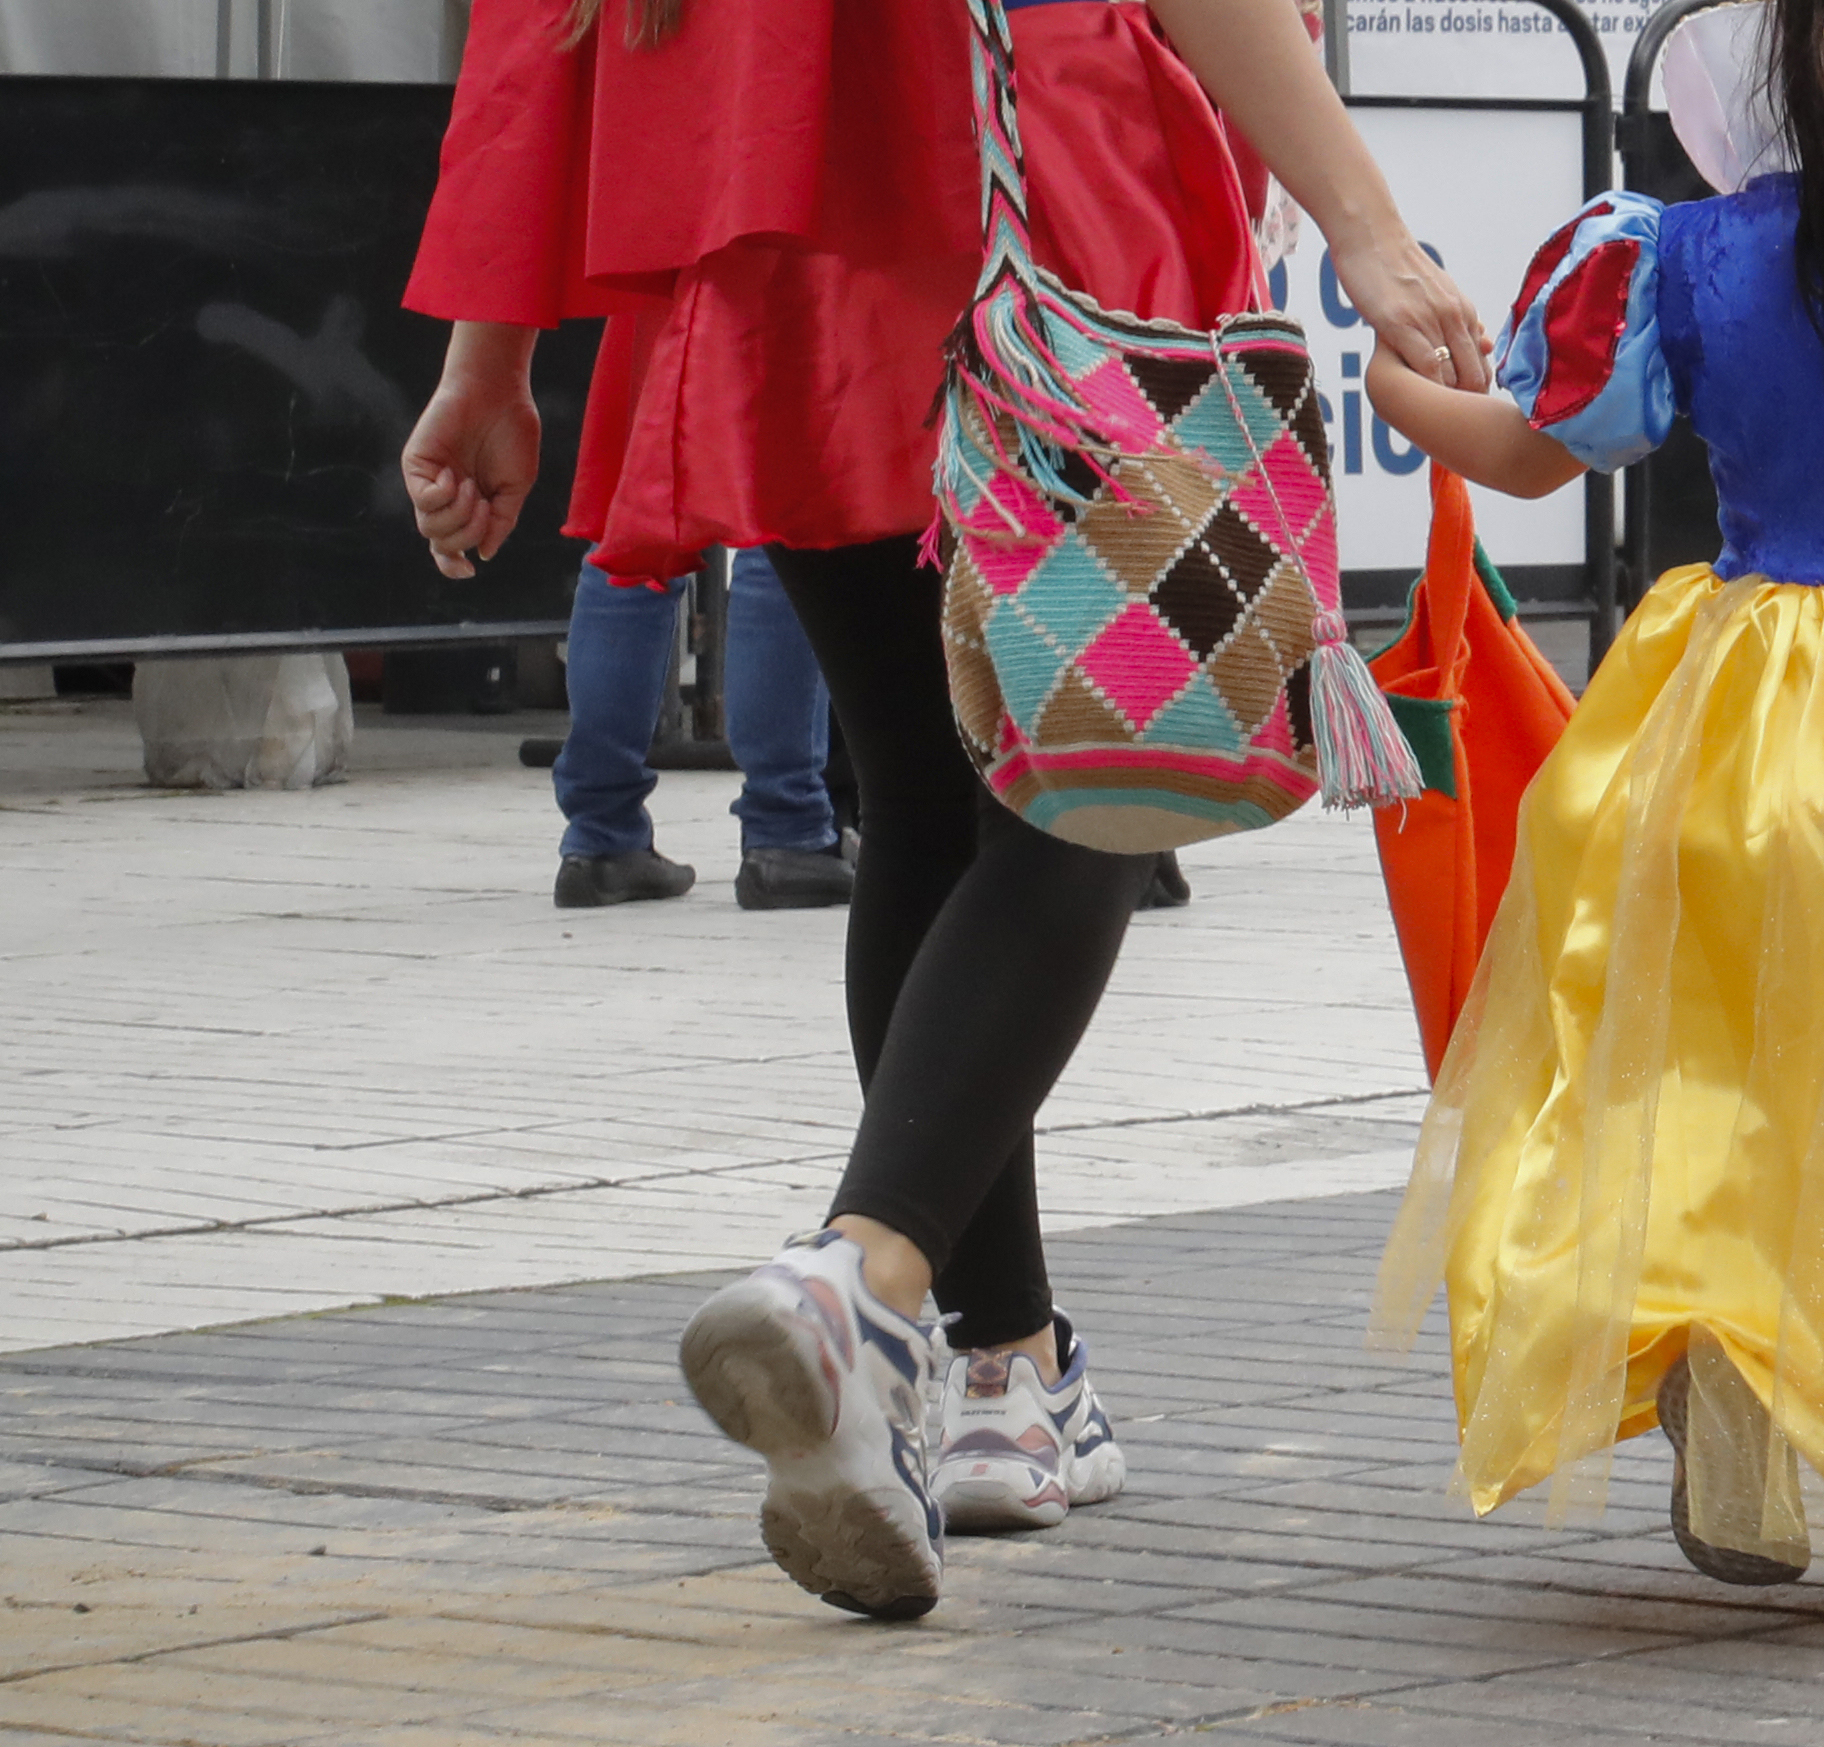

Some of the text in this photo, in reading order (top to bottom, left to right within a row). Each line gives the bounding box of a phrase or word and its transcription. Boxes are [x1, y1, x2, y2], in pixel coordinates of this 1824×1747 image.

[1405, 8, 1435, 33] las
[1440, 8, 1494, 34] dosis
[1498, 9, 1553, 34] hasta
